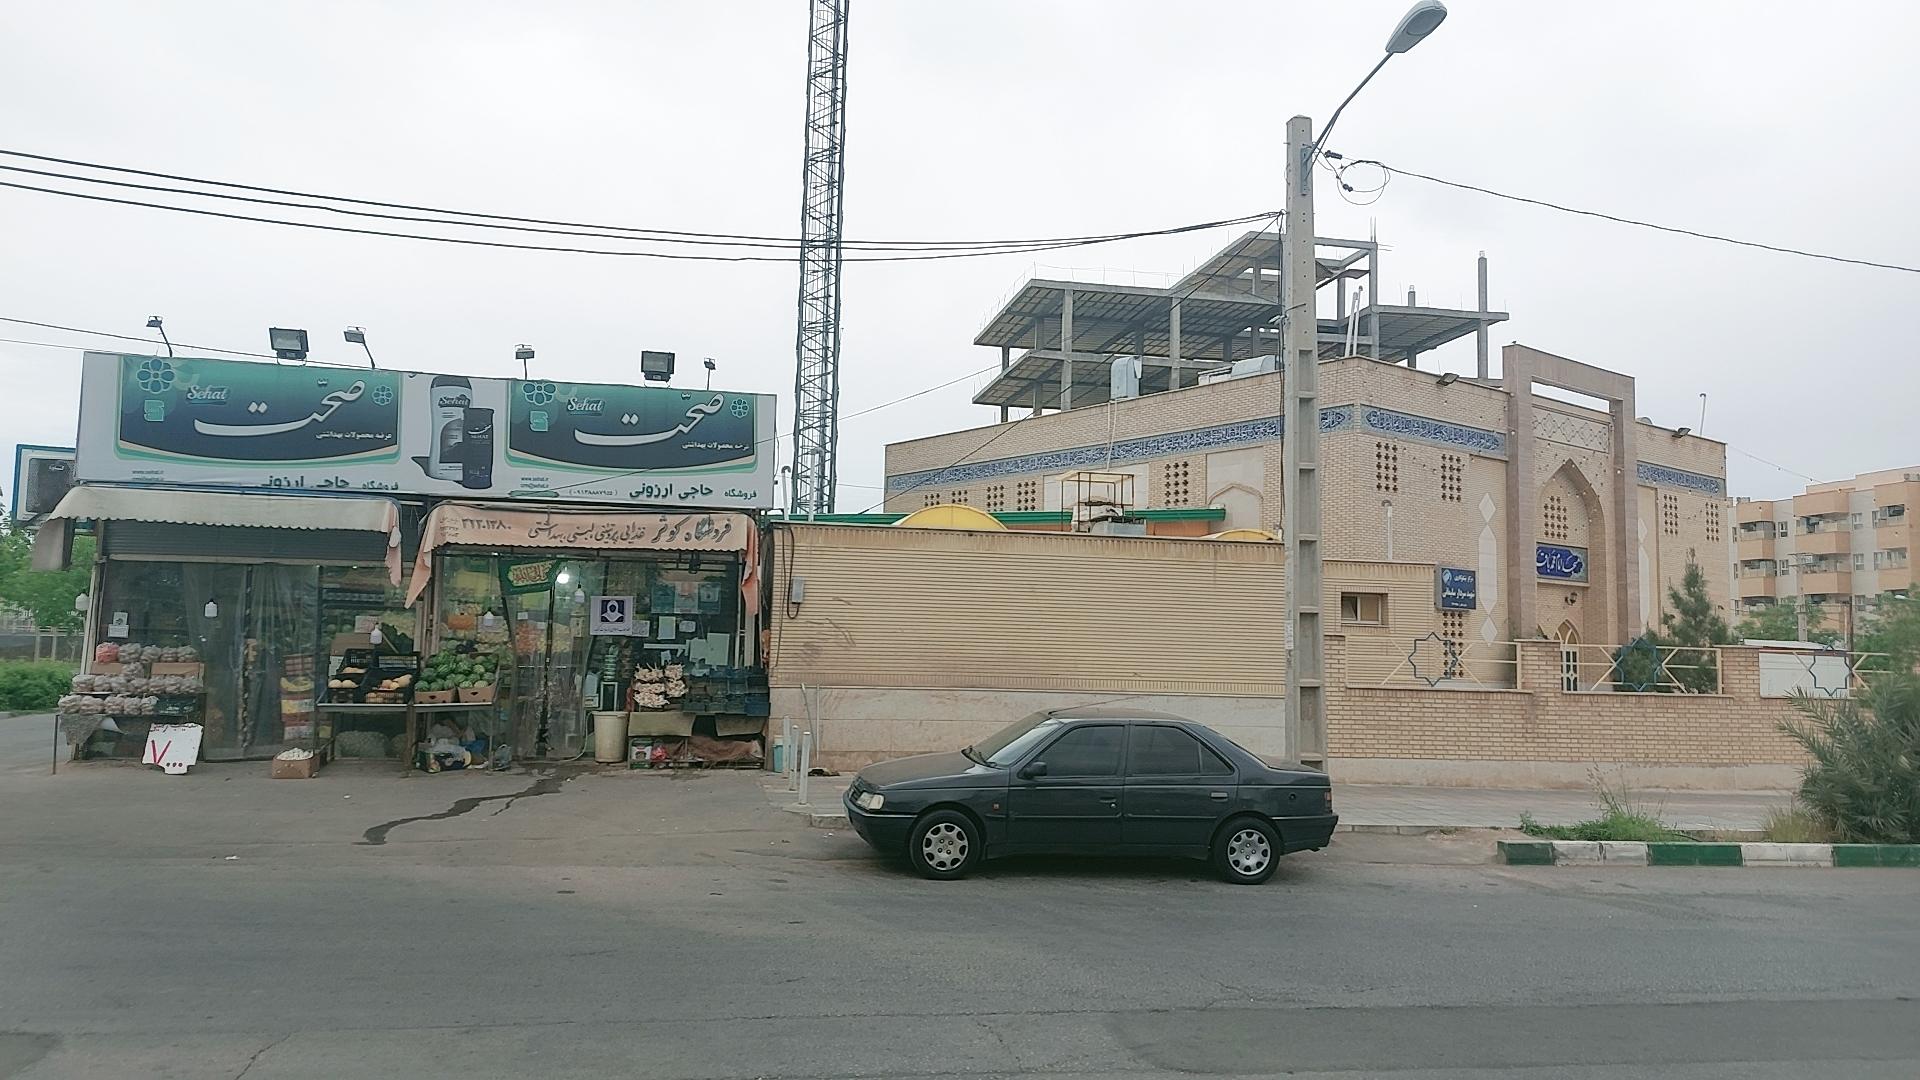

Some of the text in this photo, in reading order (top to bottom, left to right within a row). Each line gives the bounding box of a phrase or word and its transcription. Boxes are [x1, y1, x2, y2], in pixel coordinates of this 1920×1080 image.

[187, 386, 229, 401] Sehat
[194, 379, 366, 437] صحت
[567, 397, 604, 412] Sehat
[574, 392, 724, 446] صحت
[629, 482, 673, 498] ارزونی
[678, 483, 713, 499] حاجی
[724, 488, 757, 500] فروشگاه
[651, 514, 692, 543] کوثر
